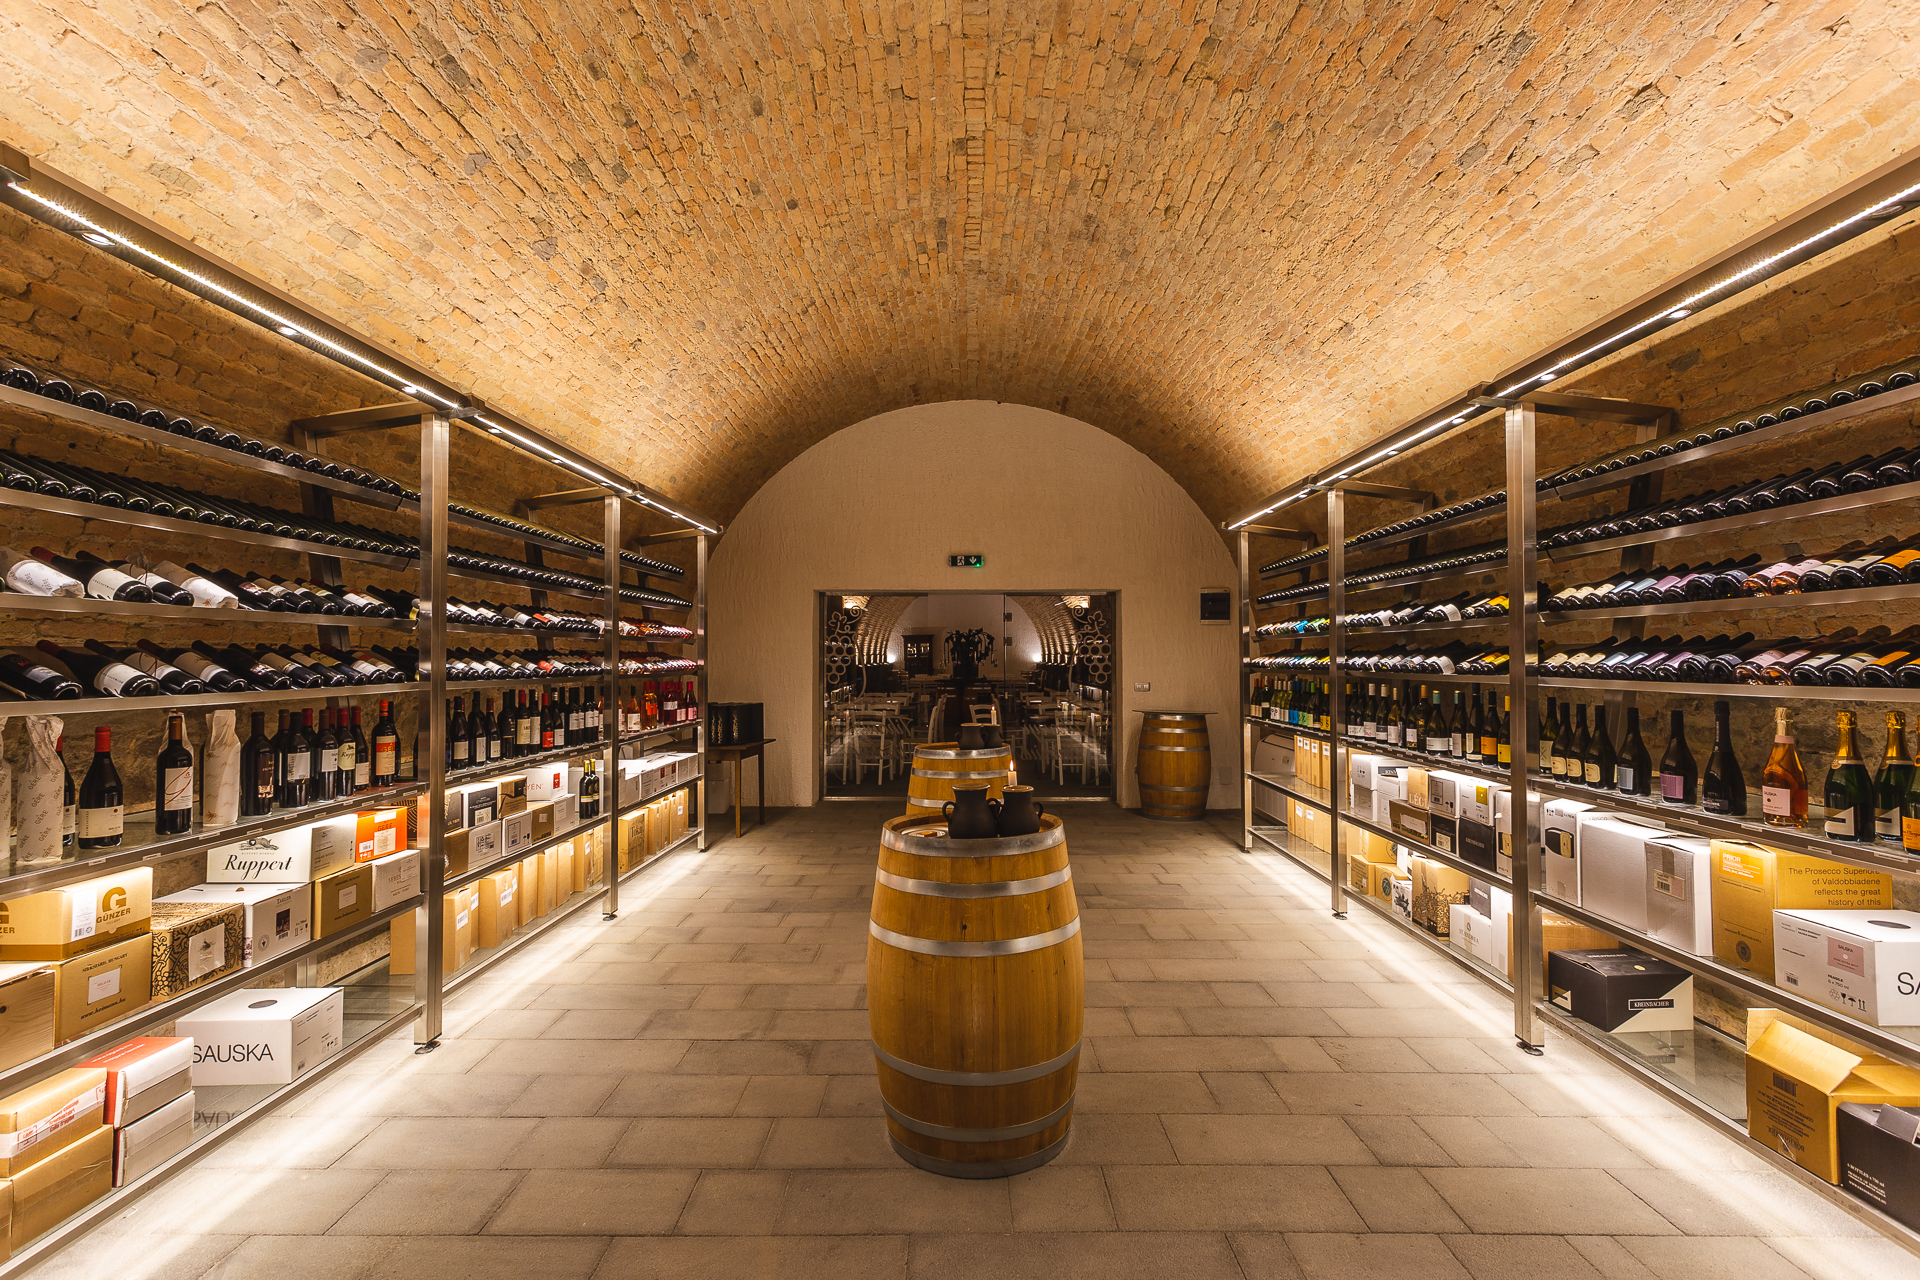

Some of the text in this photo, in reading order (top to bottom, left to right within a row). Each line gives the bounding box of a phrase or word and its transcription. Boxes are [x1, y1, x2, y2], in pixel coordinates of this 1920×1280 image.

[1722, 853, 1741, 863] PRIOR
[222, 854, 293, 880] Ruppert
[1843, 868, 1880, 876] Superiore
[1814, 888, 1881, 897] reflects the great
[1828, 898, 1881, 907] history of this
[1828, 974, 1843, 983] FRAGILE
[193, 1044, 274, 1063] SAUSKA
